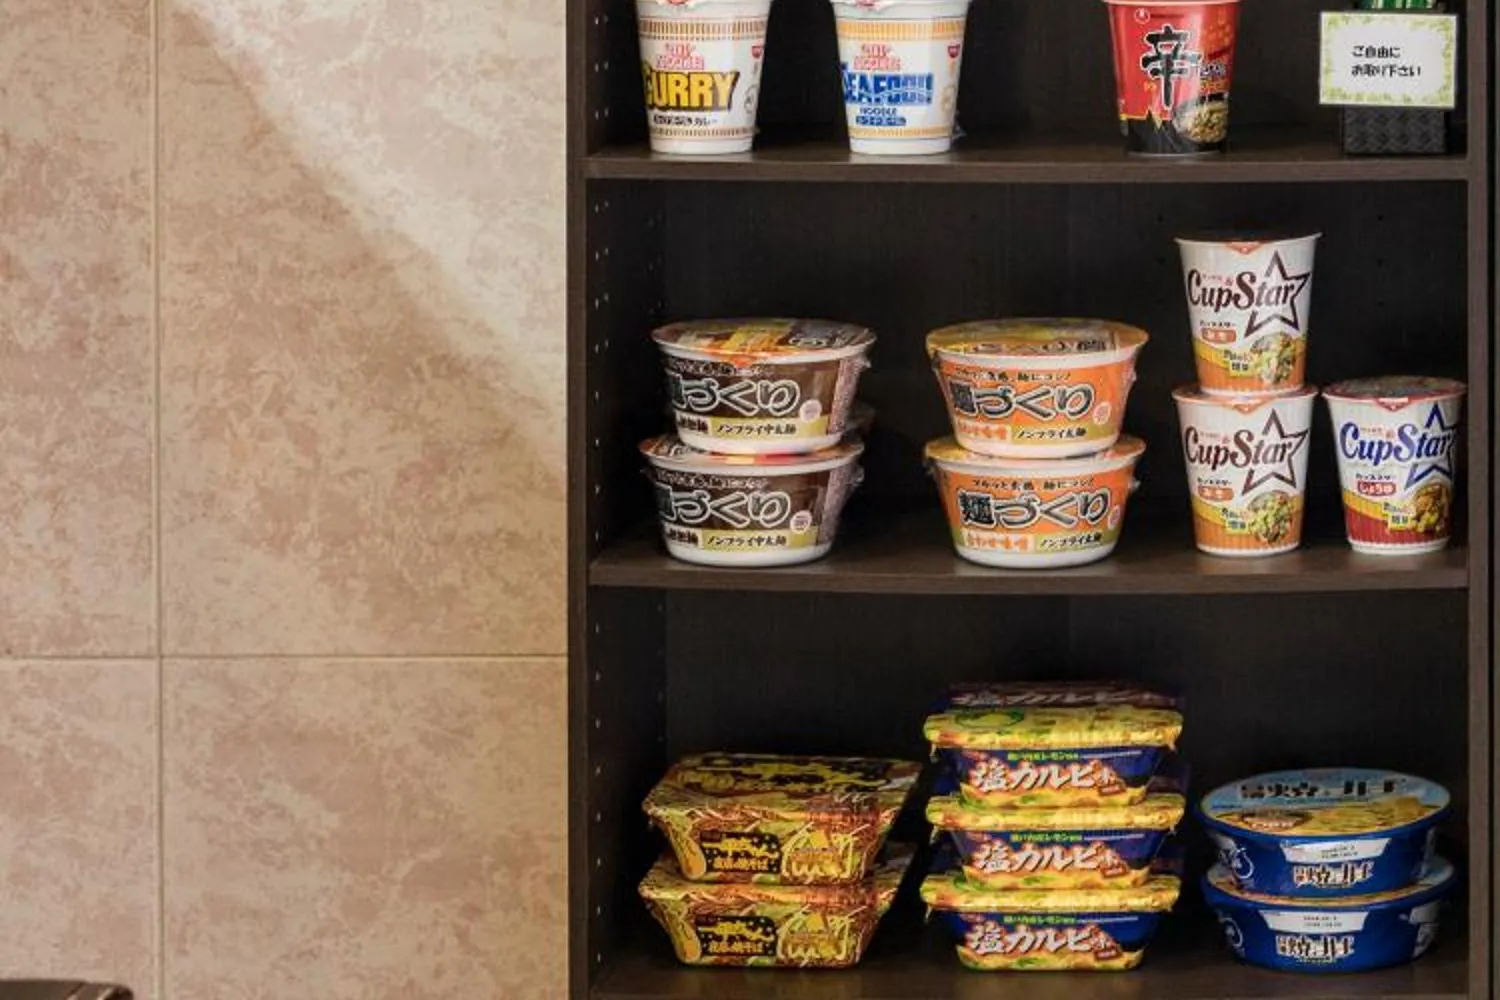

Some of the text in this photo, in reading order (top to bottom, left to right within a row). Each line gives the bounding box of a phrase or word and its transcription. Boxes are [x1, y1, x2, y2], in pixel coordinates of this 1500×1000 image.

[1140, 24, 1204, 110] 辛
[1352, 45, 1401, 59] ご自由に
[1184, 426, 1293, 471] CupStar
